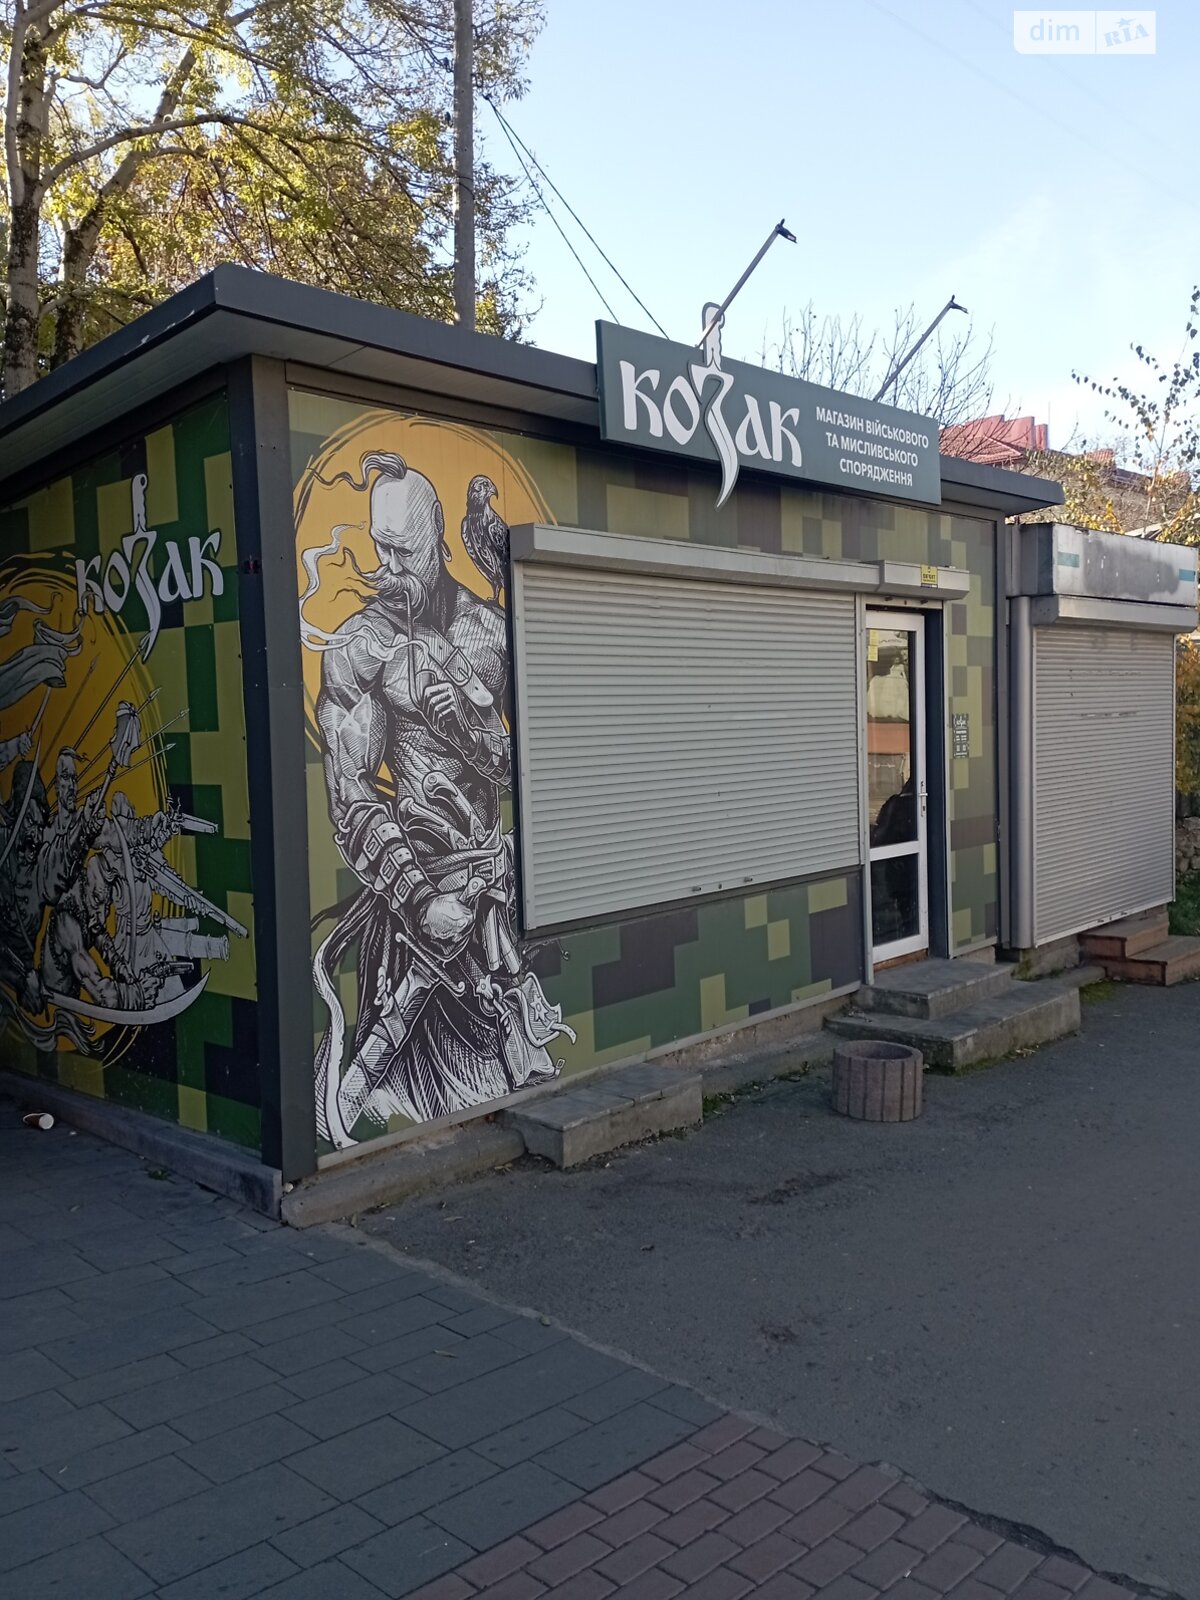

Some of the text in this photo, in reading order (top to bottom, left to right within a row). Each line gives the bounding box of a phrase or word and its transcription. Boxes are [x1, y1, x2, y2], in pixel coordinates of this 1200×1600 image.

[816, 406, 929, 449] МАГАЗИН ВІЙСЬКОВОГО
[826, 432, 919, 467] ТА МИСЛИВСЬКОГО
[840, 458, 913, 487] СПОРЯДЖЕННЯ
